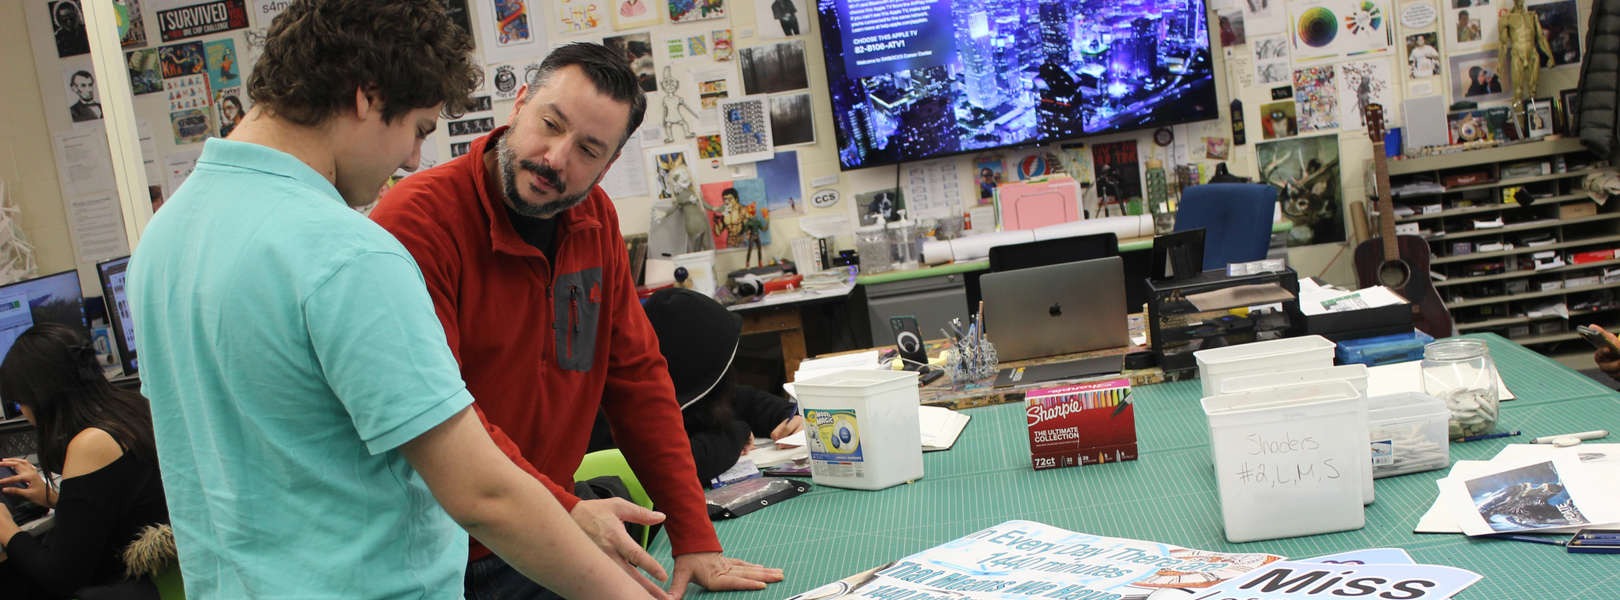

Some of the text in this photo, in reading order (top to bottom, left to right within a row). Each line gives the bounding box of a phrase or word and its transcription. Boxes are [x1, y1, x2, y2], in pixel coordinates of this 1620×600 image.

[160, 14, 166, 31] I
[166, 2, 228, 30] SURVIVED
[853, 36, 877, 45] CHOOSE
[892, 32, 909, 40] APPLE
[815, 193, 836, 204] CCS
[1026, 399, 1082, 427] Sharpie
[1034, 433, 1079, 443] COLLECTION
[1047, 426, 1078, 436] ULTIMATE
[1248, 432, 1320, 455] Shaders
[1034, 457, 1056, 466] 72ct
[988, 530, 1057, 556] Every
[1056, 543, 1104, 560] Day
[1106, 548, 1183, 567] There
[1176, 562, 1228, 572] are
[977, 552, 1132, 578] 1440 minutes
[878, 561, 1122, 600] That Means We Have
[1239, 568, 1436, 600] Miss
